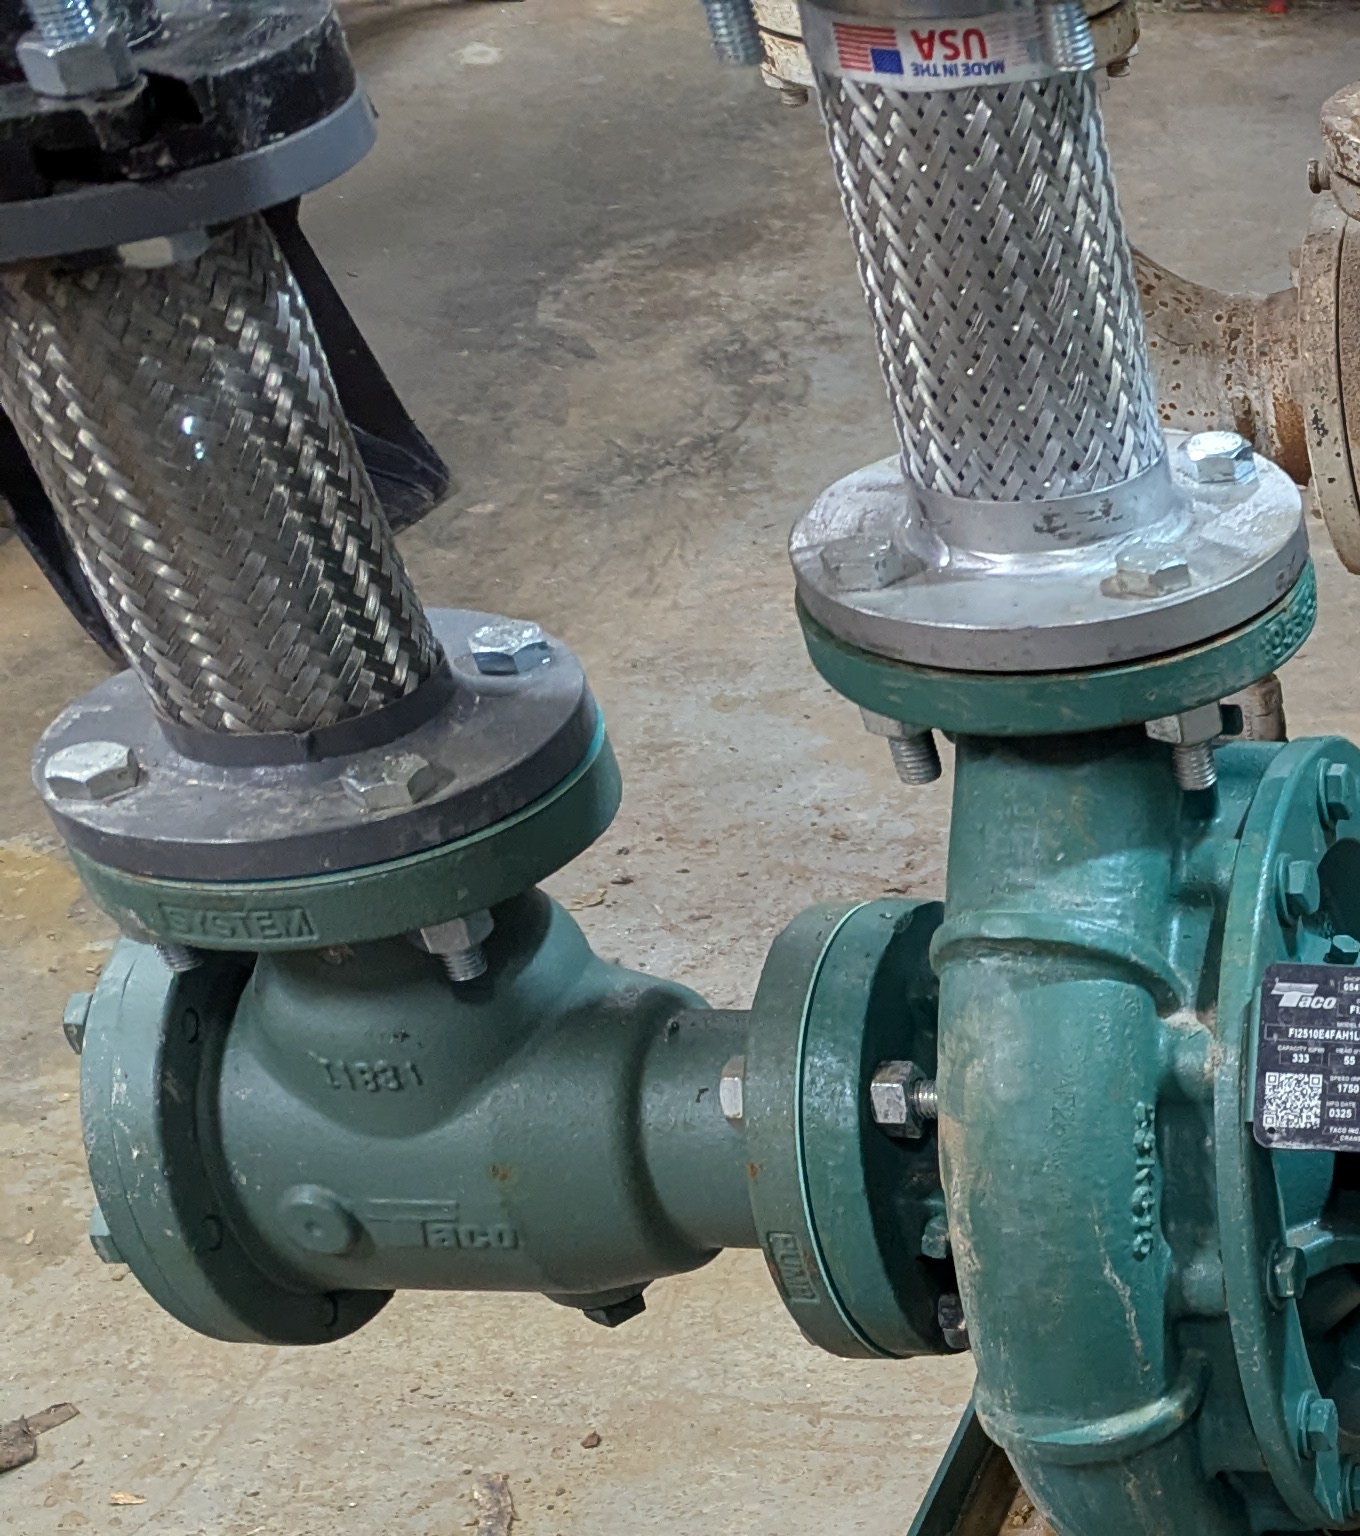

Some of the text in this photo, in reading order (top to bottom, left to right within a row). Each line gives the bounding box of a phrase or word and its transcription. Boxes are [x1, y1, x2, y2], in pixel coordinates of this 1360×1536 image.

[911, 27, 987, 61] USA
[912, 59, 1005, 77] MADE IN THE
[1271, 982, 1337, 1009] Taco
[1292, 1053, 1310, 1063] 333
[1343, 1055, 1356, 1066] 55
[1337, 1084, 1360, 1094] 1750
[1328, 1108, 1353, 1119] 0325
